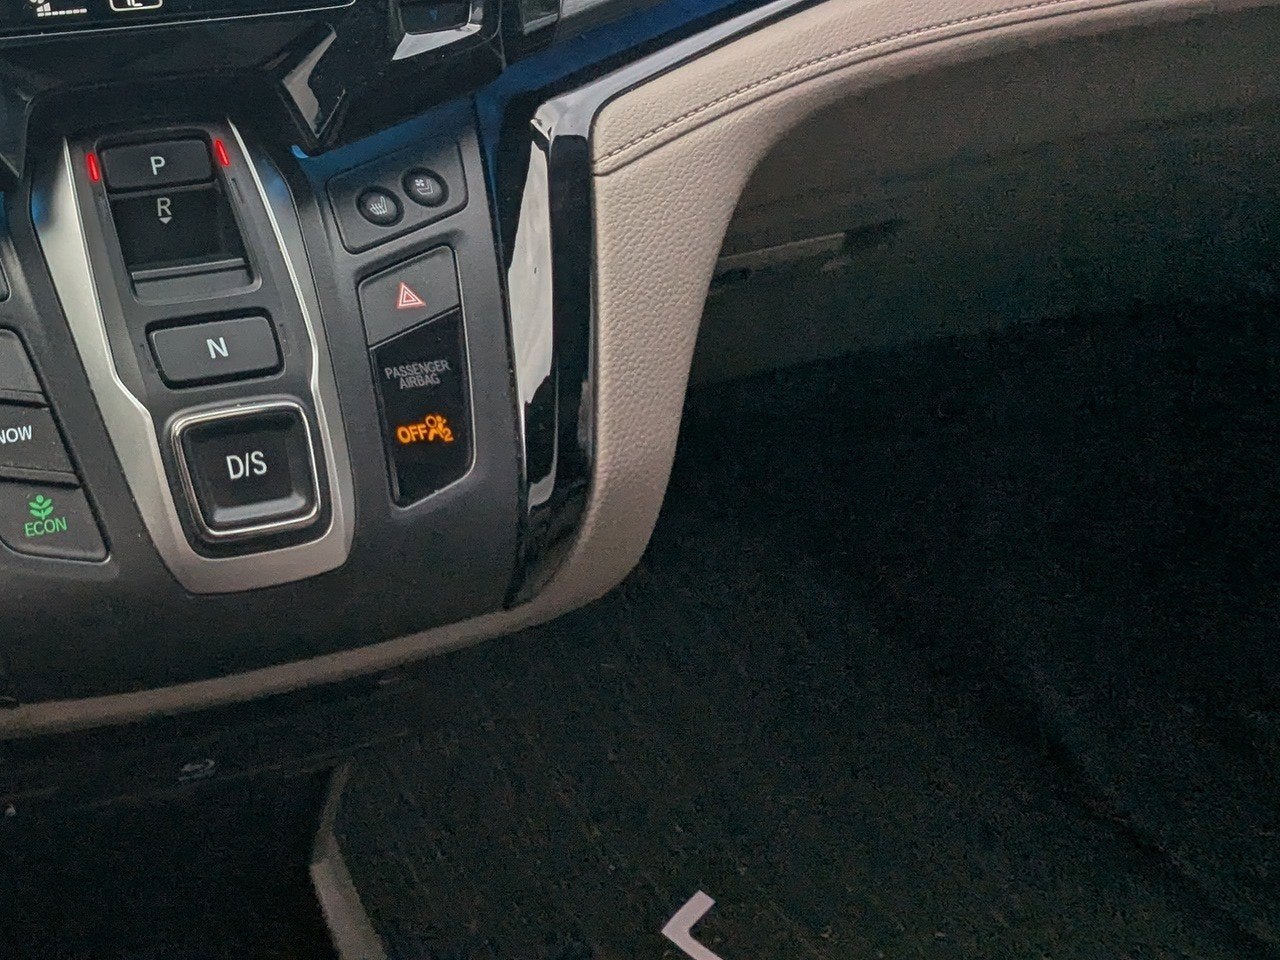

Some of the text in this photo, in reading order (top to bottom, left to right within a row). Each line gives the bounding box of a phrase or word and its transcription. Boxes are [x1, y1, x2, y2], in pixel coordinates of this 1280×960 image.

[149, 155, 166, 176] P
[156, 197, 172, 217] R
[206, 336, 230, 360] N
[384, 359, 451, 380] PASSENGER
[398, 373, 441, 390] AIRBAG
[396, 423, 428, 444] OFF
[226, 450, 268, 480] D/S
[24, 516, 68, 537] ECON
